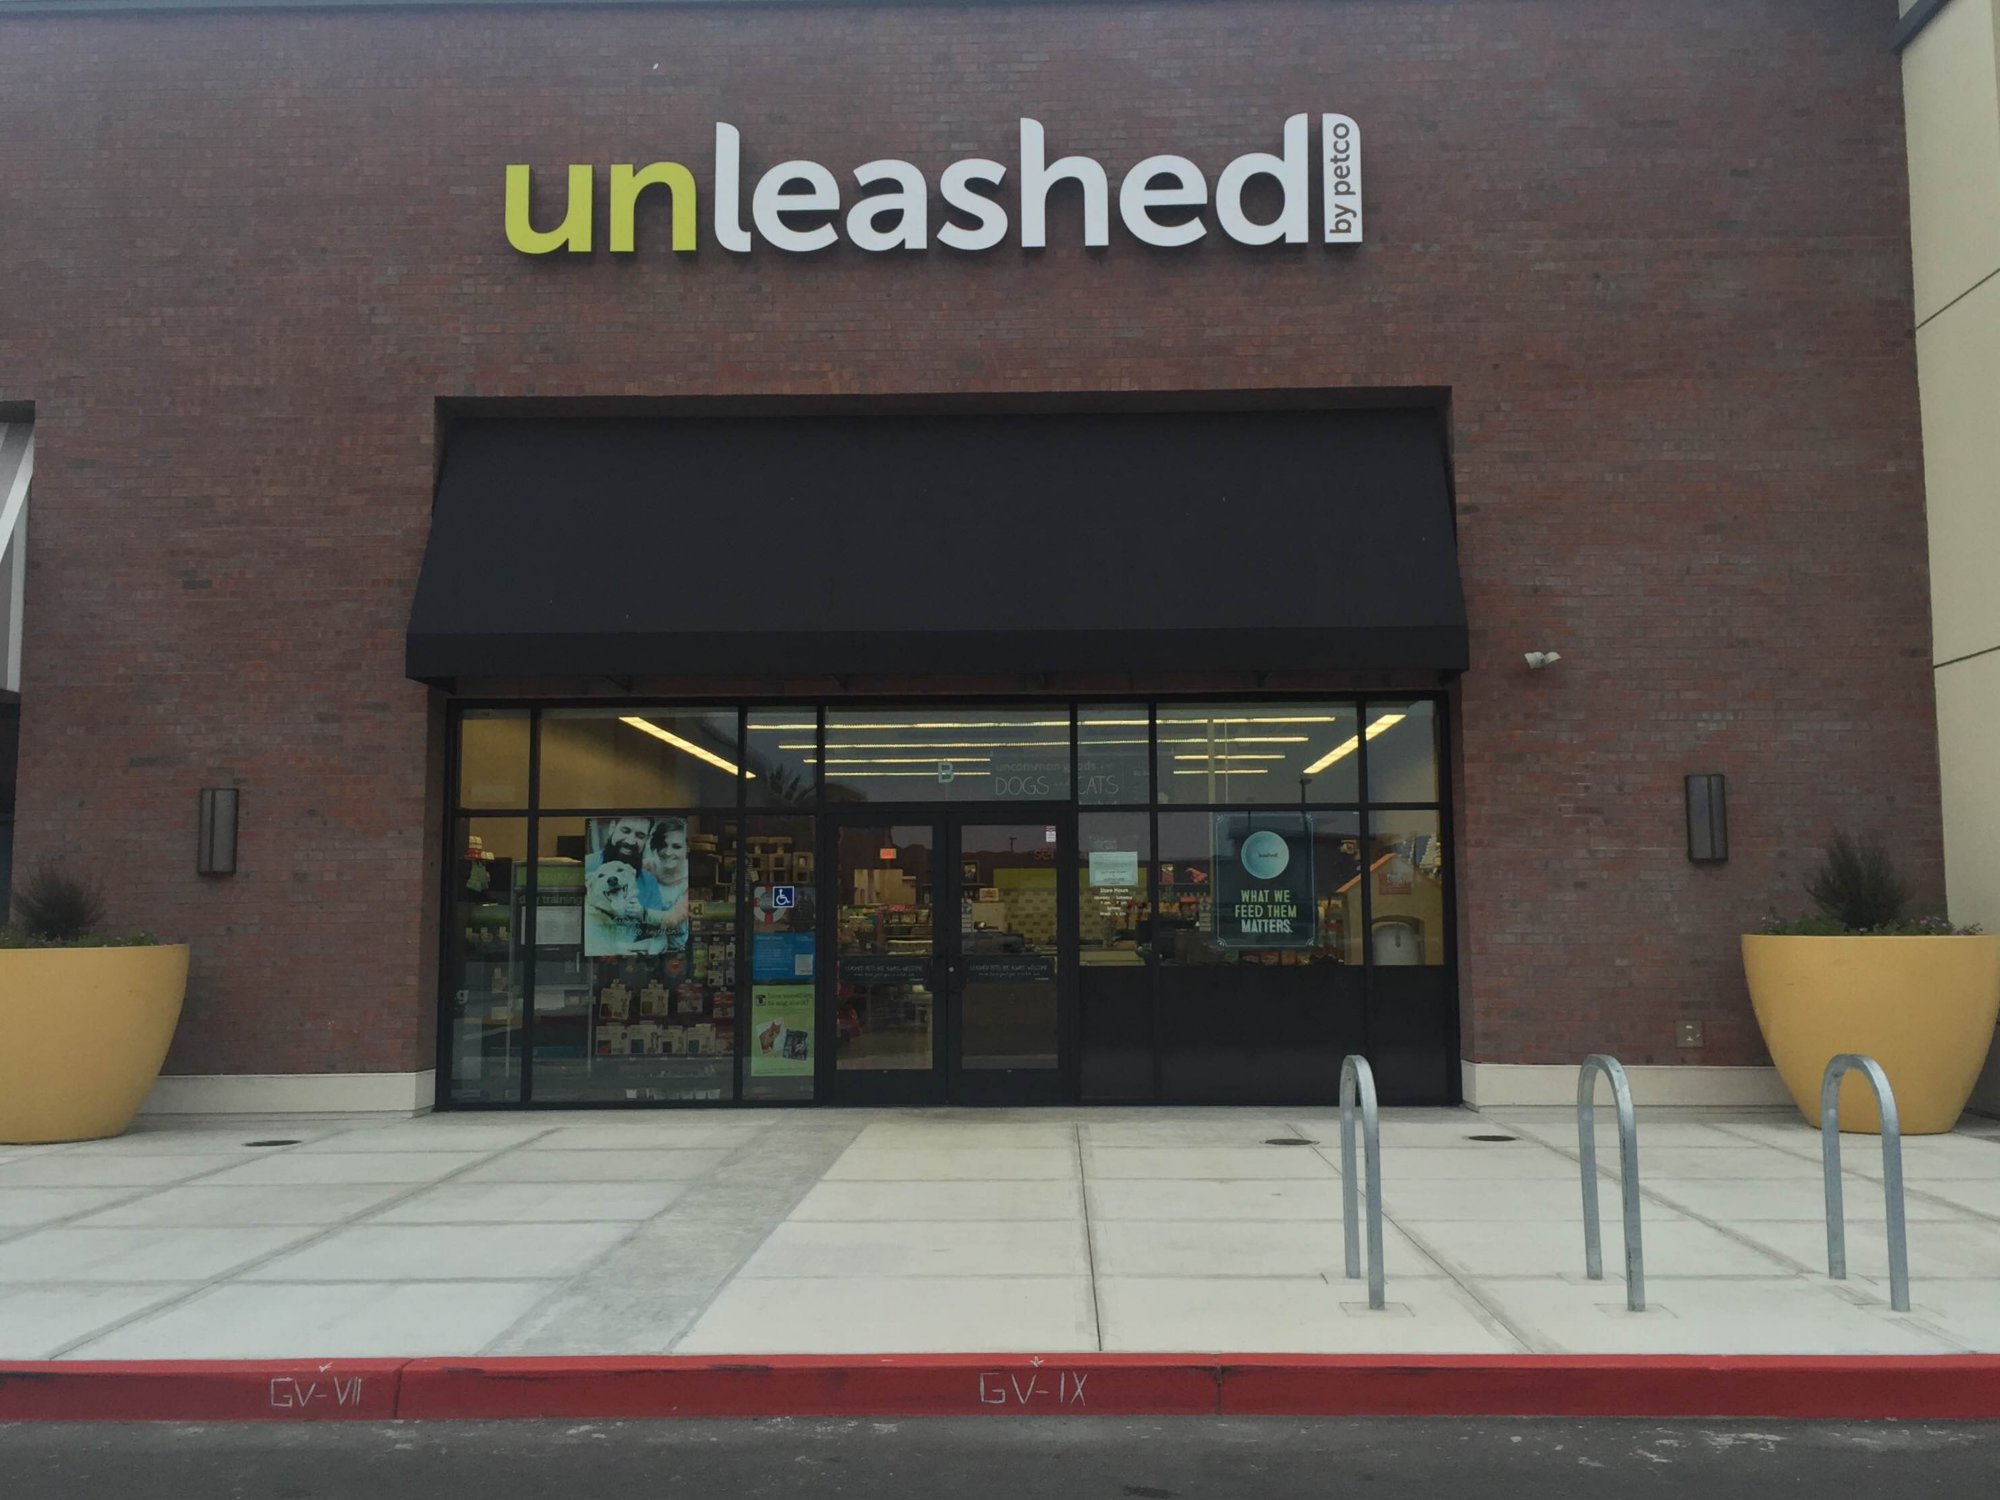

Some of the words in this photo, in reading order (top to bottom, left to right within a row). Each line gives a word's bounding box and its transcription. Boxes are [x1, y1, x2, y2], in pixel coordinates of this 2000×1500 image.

[1330, 122, 1356, 196] petco
[504, 112, 1309, 253] unleashed
[1329, 203, 1357, 234] by
[938, 762, 954, 783] B
[995, 776, 1050, 796] DOGS
[1235, 904, 1264, 918] FEED
[1267, 904, 1297, 918] THEM
[1241, 889, 1269, 903] WHAT
[1274, 889, 1291, 903] WE
[270, 1376, 362, 1407] GV-VII
[979, 1370, 1088, 1407] GV-IX
